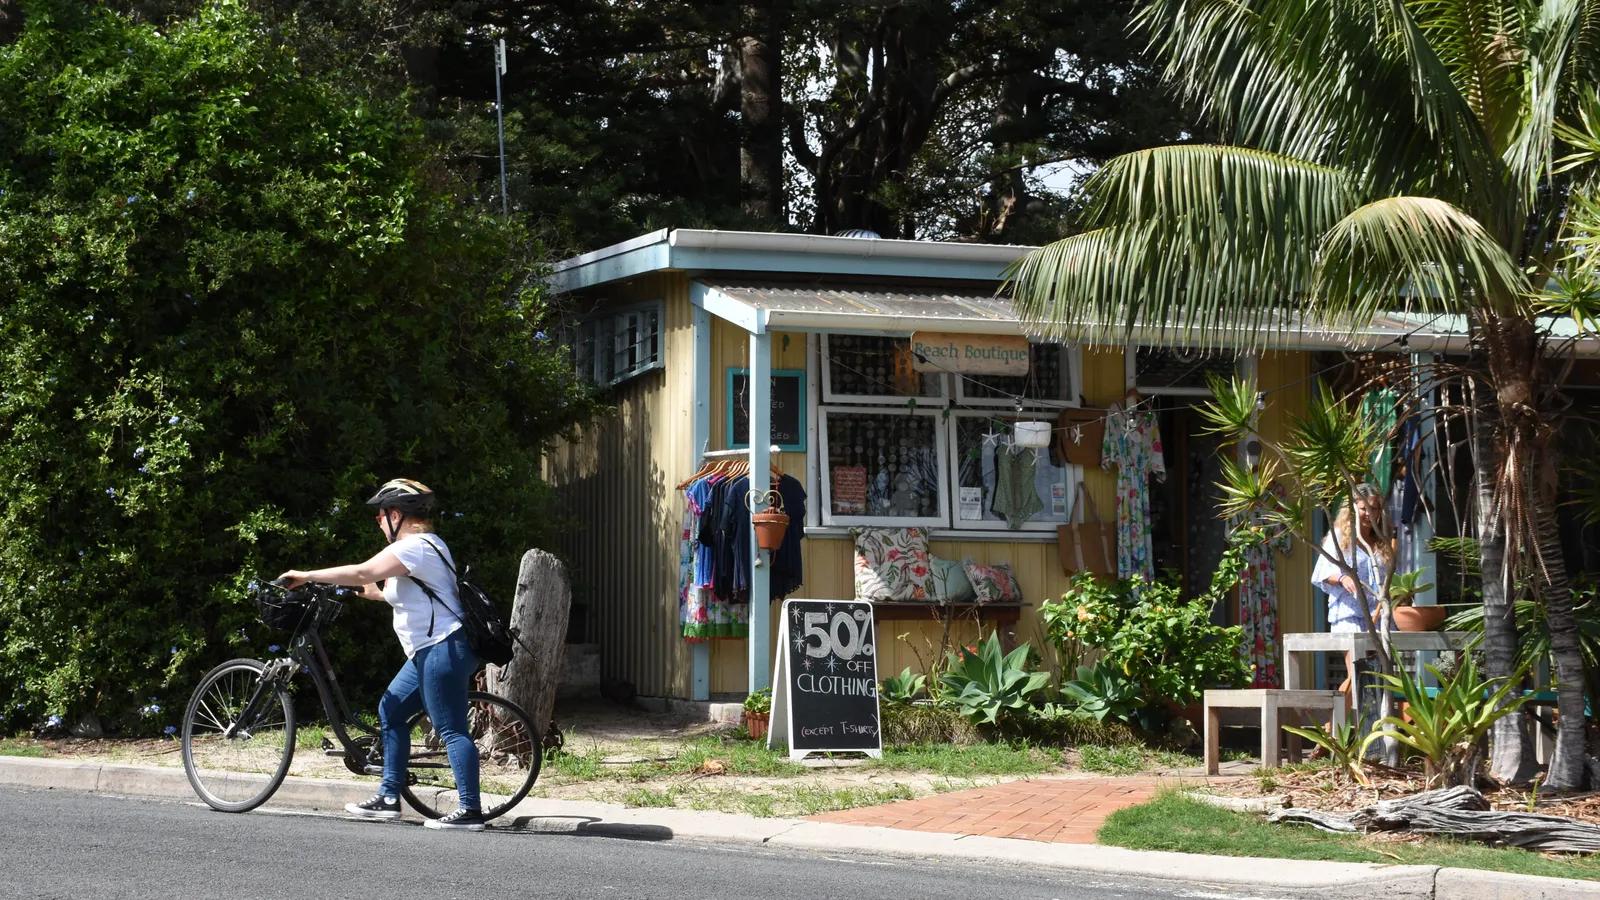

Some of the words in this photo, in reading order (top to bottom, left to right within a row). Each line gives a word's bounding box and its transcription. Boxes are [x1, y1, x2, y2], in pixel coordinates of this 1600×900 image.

[914, 342, 959, 358] Beach
[965, 345, 1027, 365] Boutique
[804, 609, 873, 660] 50%
[846, 660, 873, 673] OFF
[797, 673, 876, 698] CLOTHING
